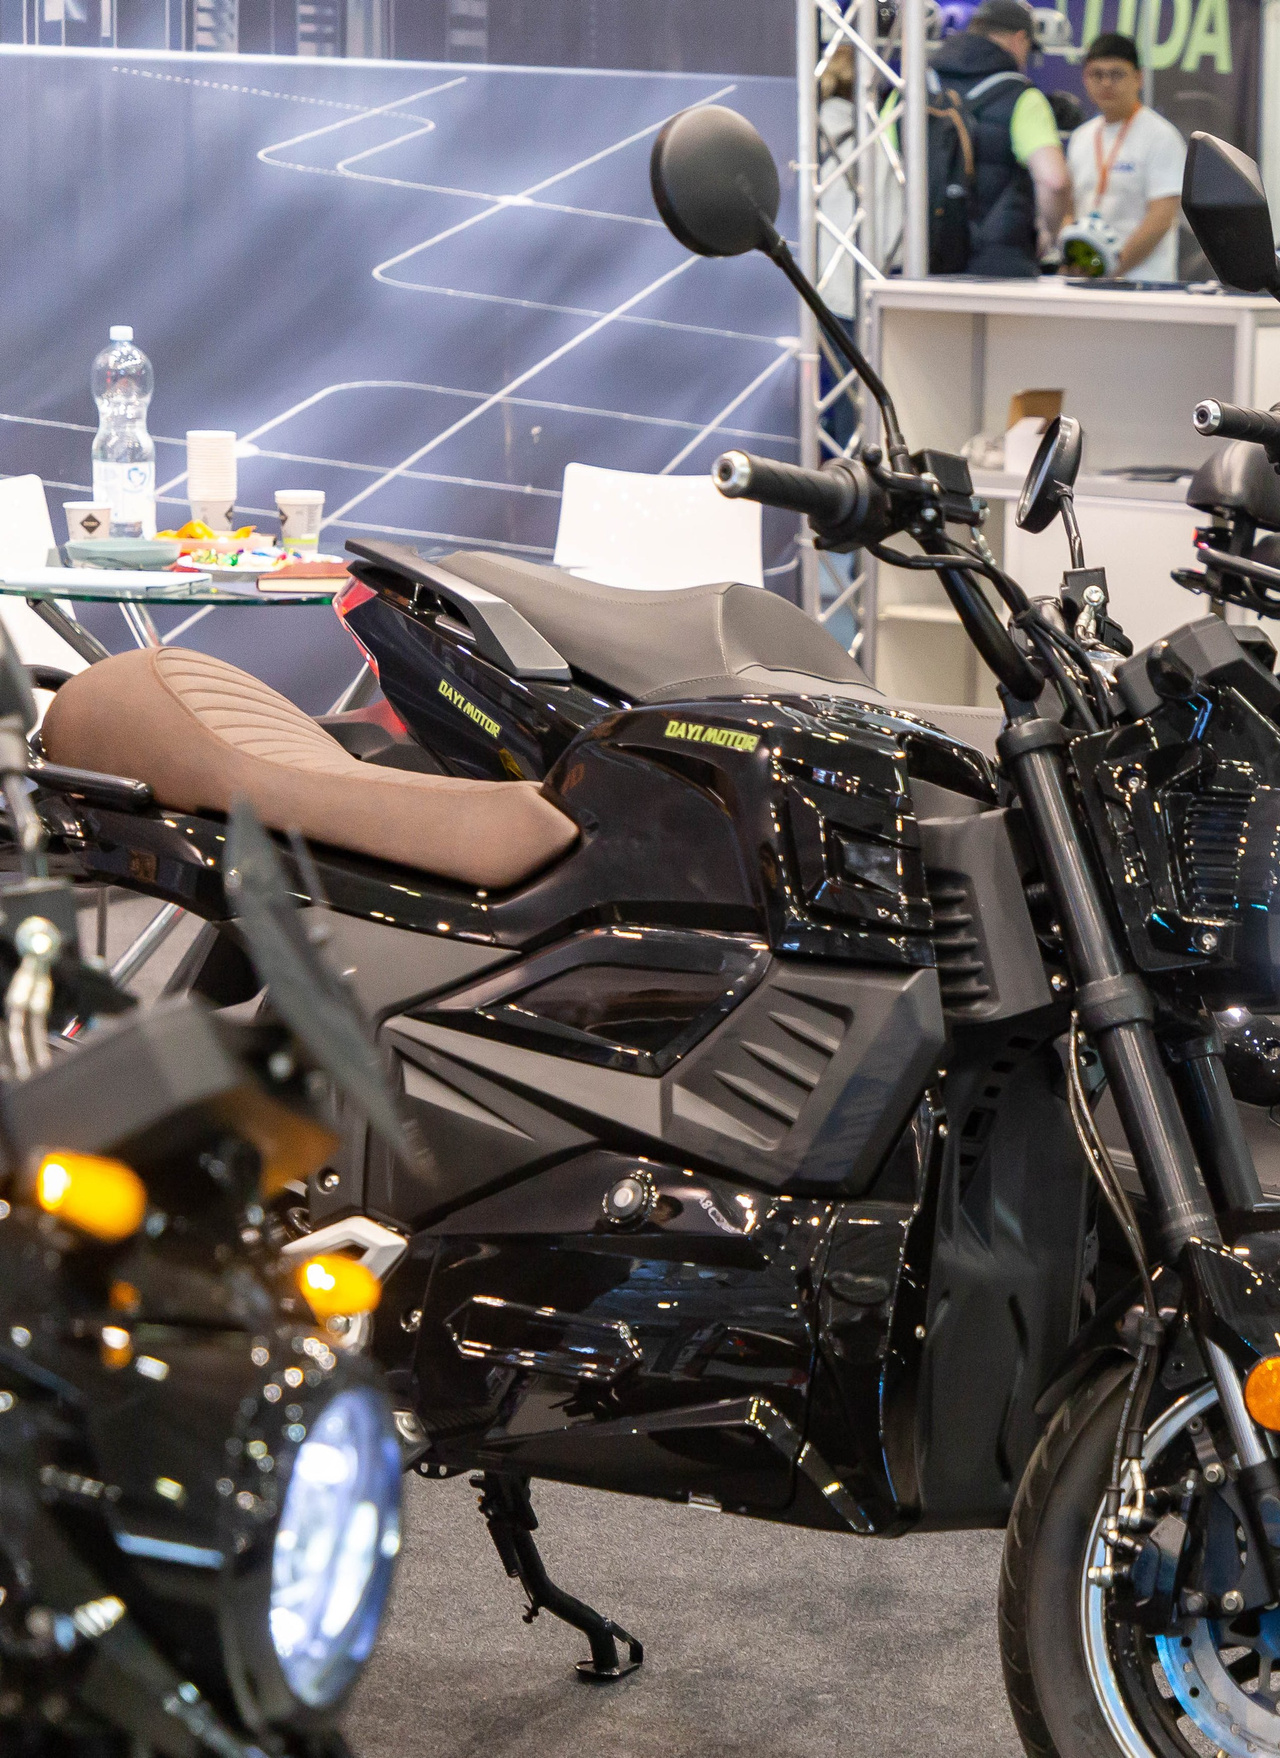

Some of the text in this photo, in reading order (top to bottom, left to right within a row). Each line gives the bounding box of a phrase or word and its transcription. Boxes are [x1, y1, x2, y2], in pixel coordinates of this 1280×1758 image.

[438, 679, 501, 738] DAYI MOTOR
[664, 720, 758, 752] DAYI MOTOR
